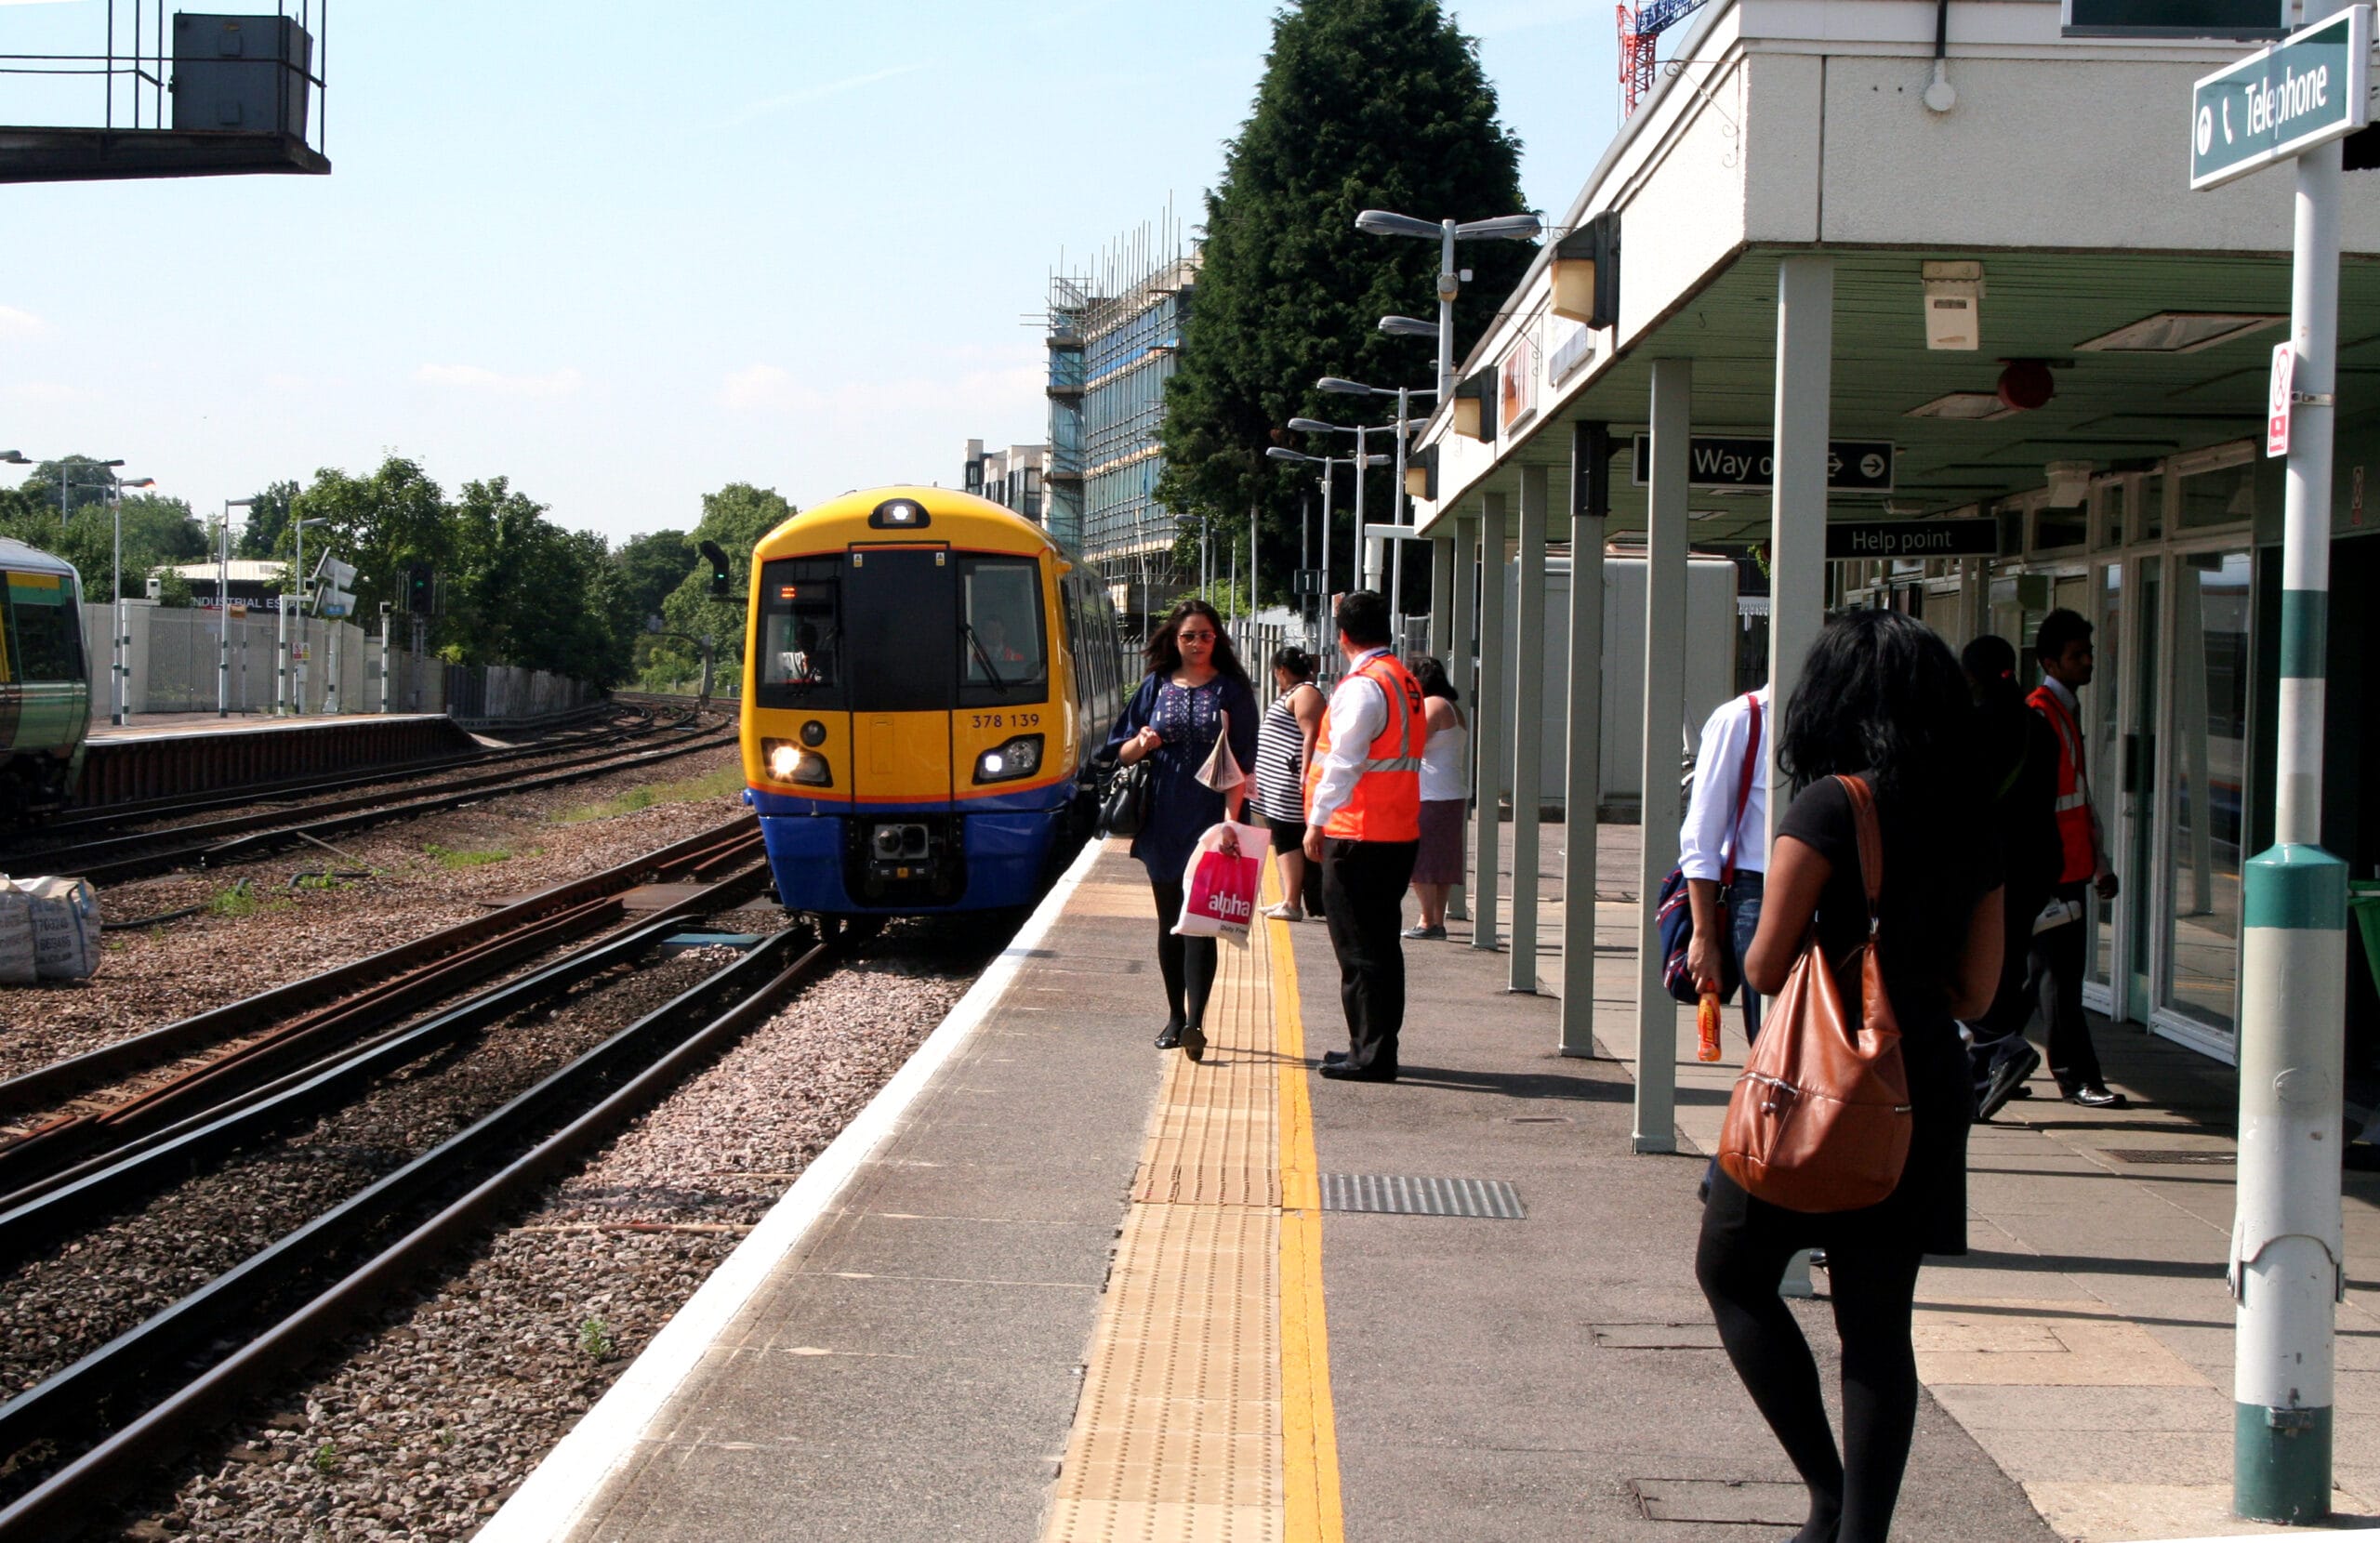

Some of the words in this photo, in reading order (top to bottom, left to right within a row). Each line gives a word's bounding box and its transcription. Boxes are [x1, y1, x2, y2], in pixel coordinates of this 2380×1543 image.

[2244, 64, 2327, 140] Telephone
[1694, 447, 1752, 481] Way
[1852, 530, 1896, 555] Help
[1902, 528, 1952, 554] point
[1303, 574, 1310, 590] 1
[972, 714, 1002, 729] 378
[1011, 712, 1039, 728] 139
[1209, 890, 1250, 918] alpha
